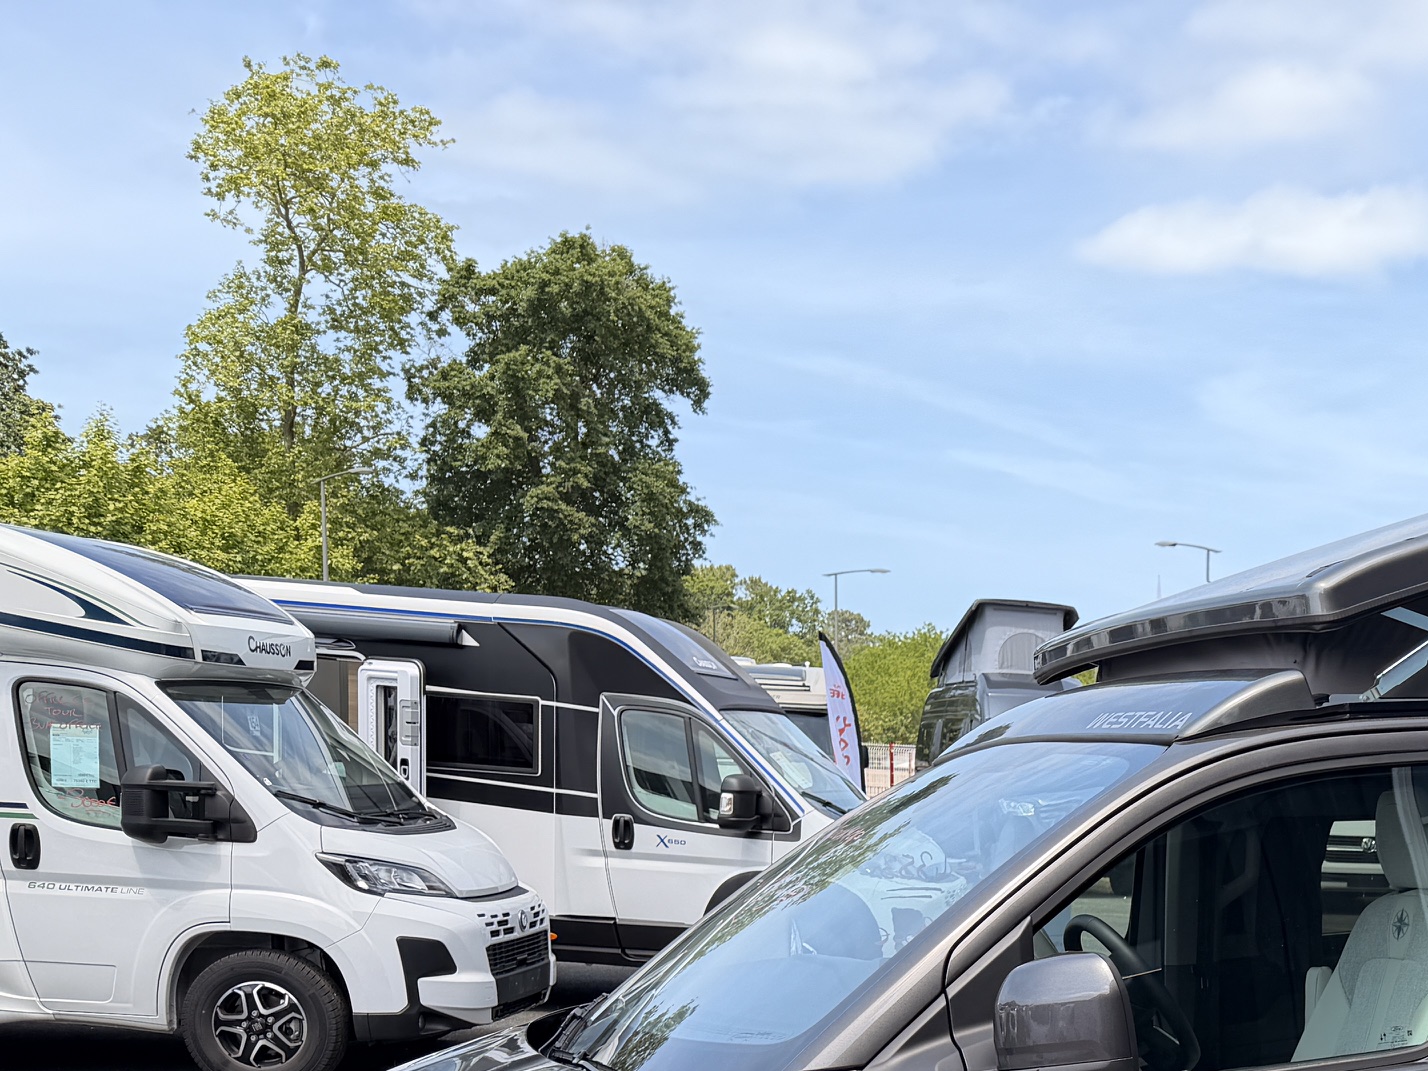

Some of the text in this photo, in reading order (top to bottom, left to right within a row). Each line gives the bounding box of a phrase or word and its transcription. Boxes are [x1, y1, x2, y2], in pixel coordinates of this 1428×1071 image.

[247, 635, 292, 658] CHAUSSON
[1086, 711, 1193, 729] WESTFALIA
[27, 881, 145, 895] 640 ULTIMATE LINE
